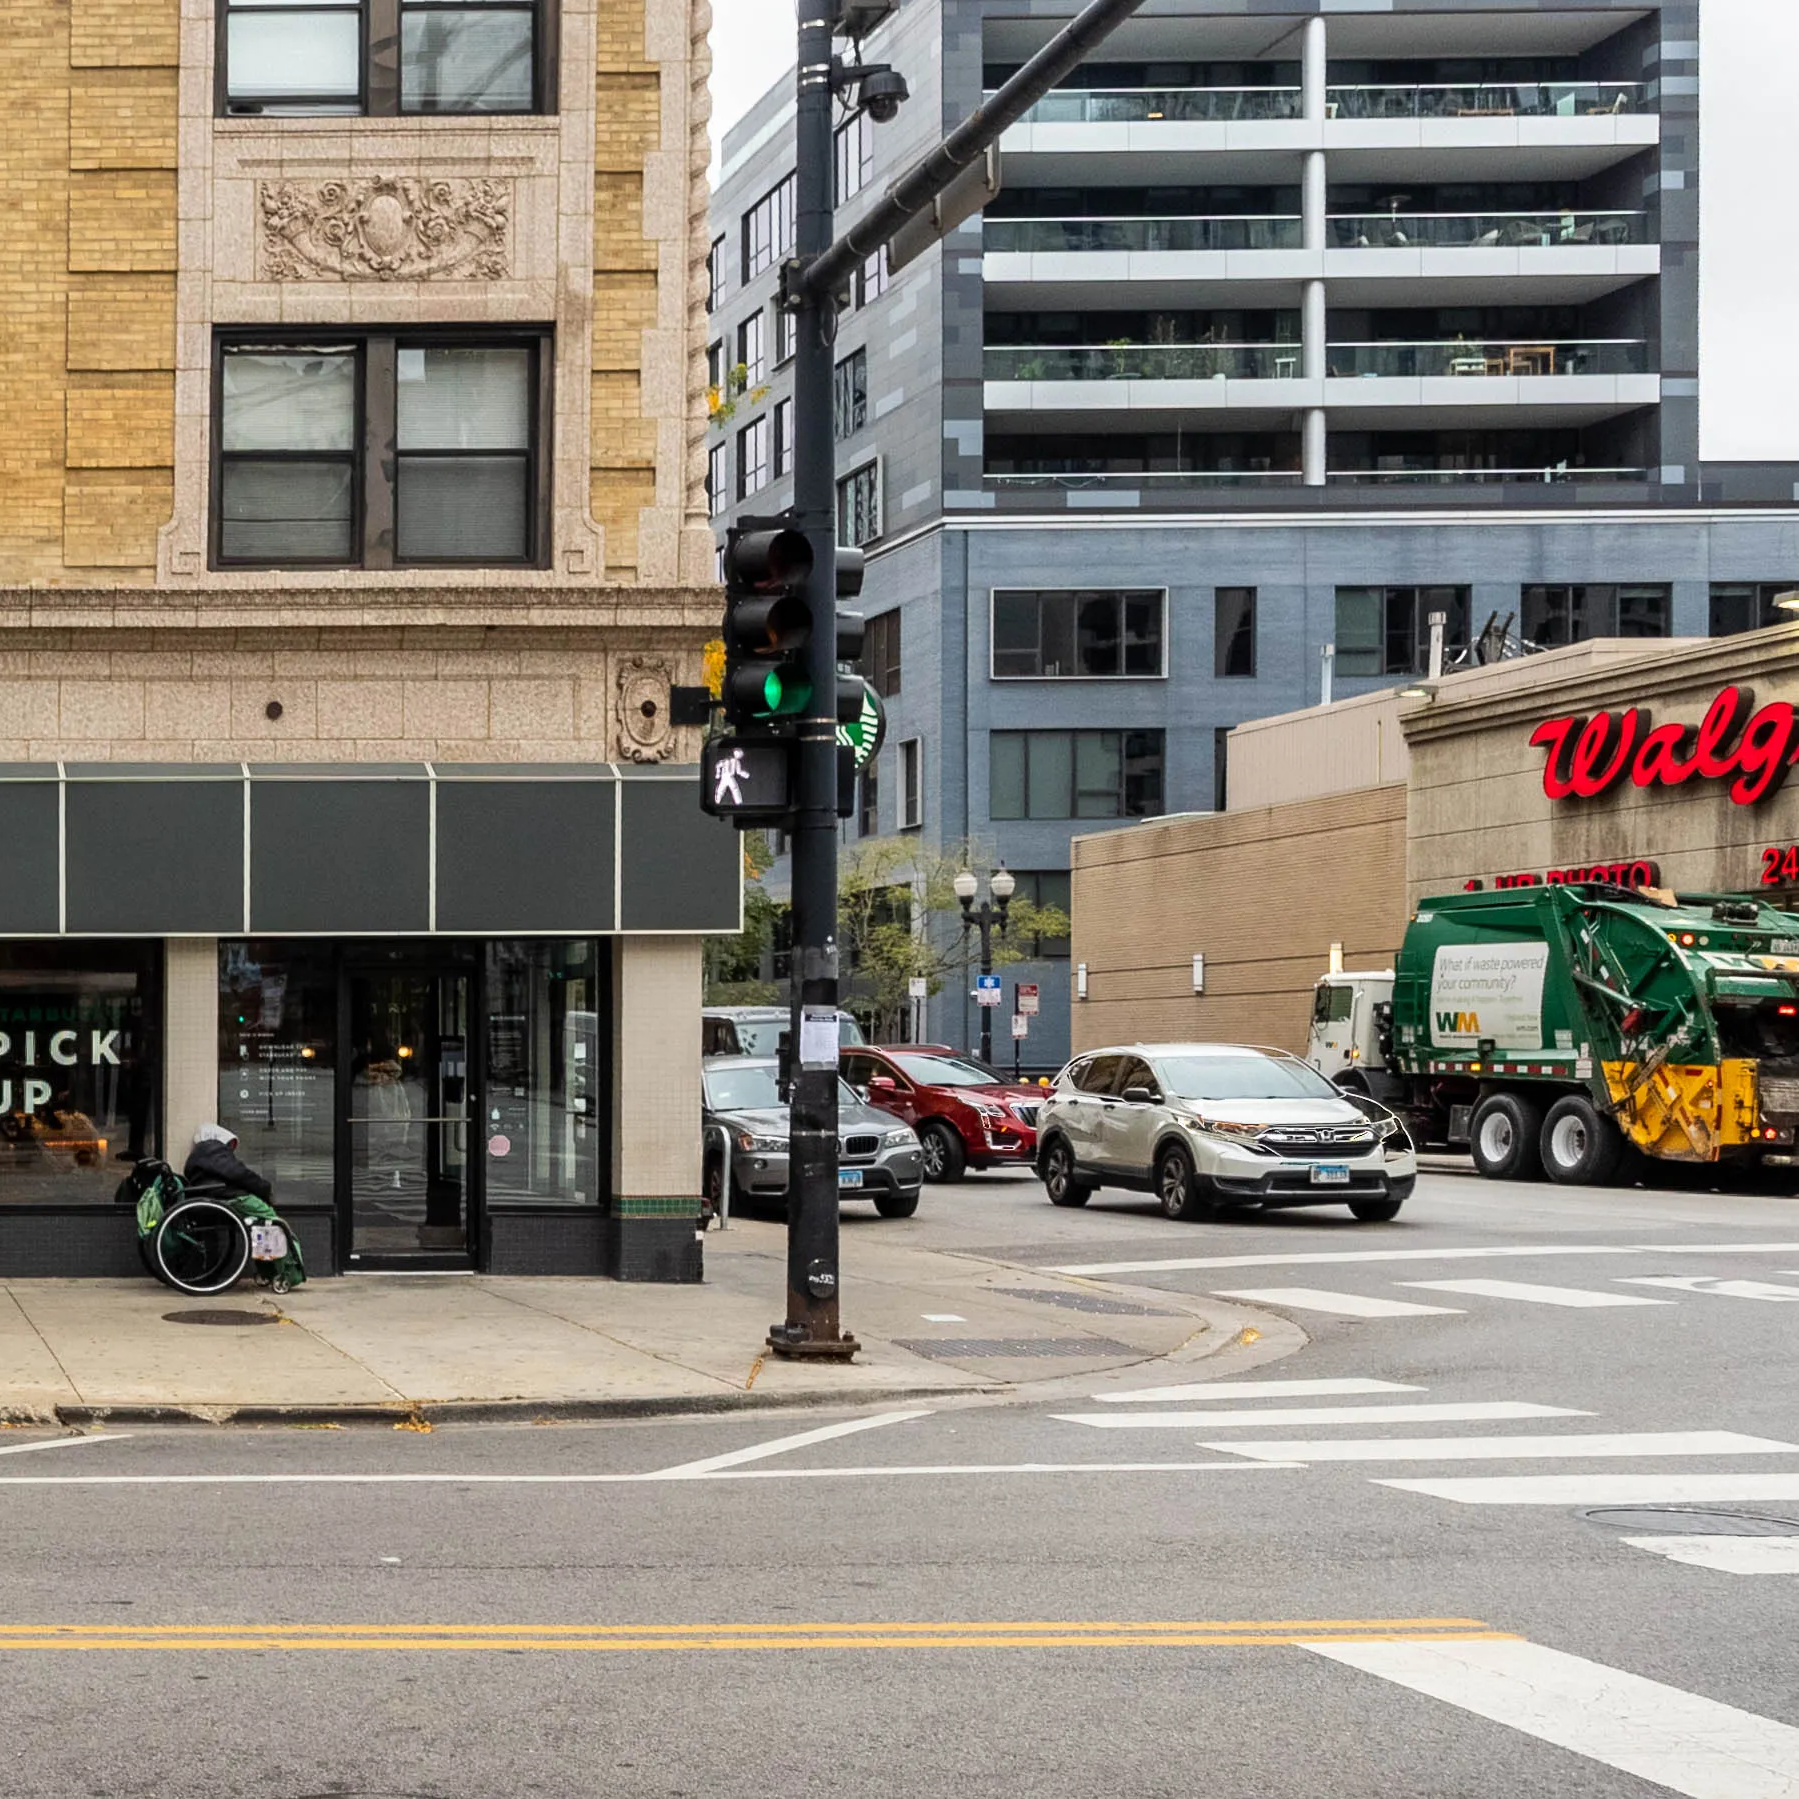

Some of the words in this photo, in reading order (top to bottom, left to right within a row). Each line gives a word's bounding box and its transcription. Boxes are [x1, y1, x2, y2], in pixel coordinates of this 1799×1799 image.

[1529, 686, 1799, 805] Walg
[1439, 957, 1463, 971] What
[1473, 957, 1500, 971] waste
[1500, 955, 1544, 973] powered
[1437, 979, 1457, 994] your
[1459, 975, 1517, 993] community?
[1436, 1012, 1481, 1033] WM
